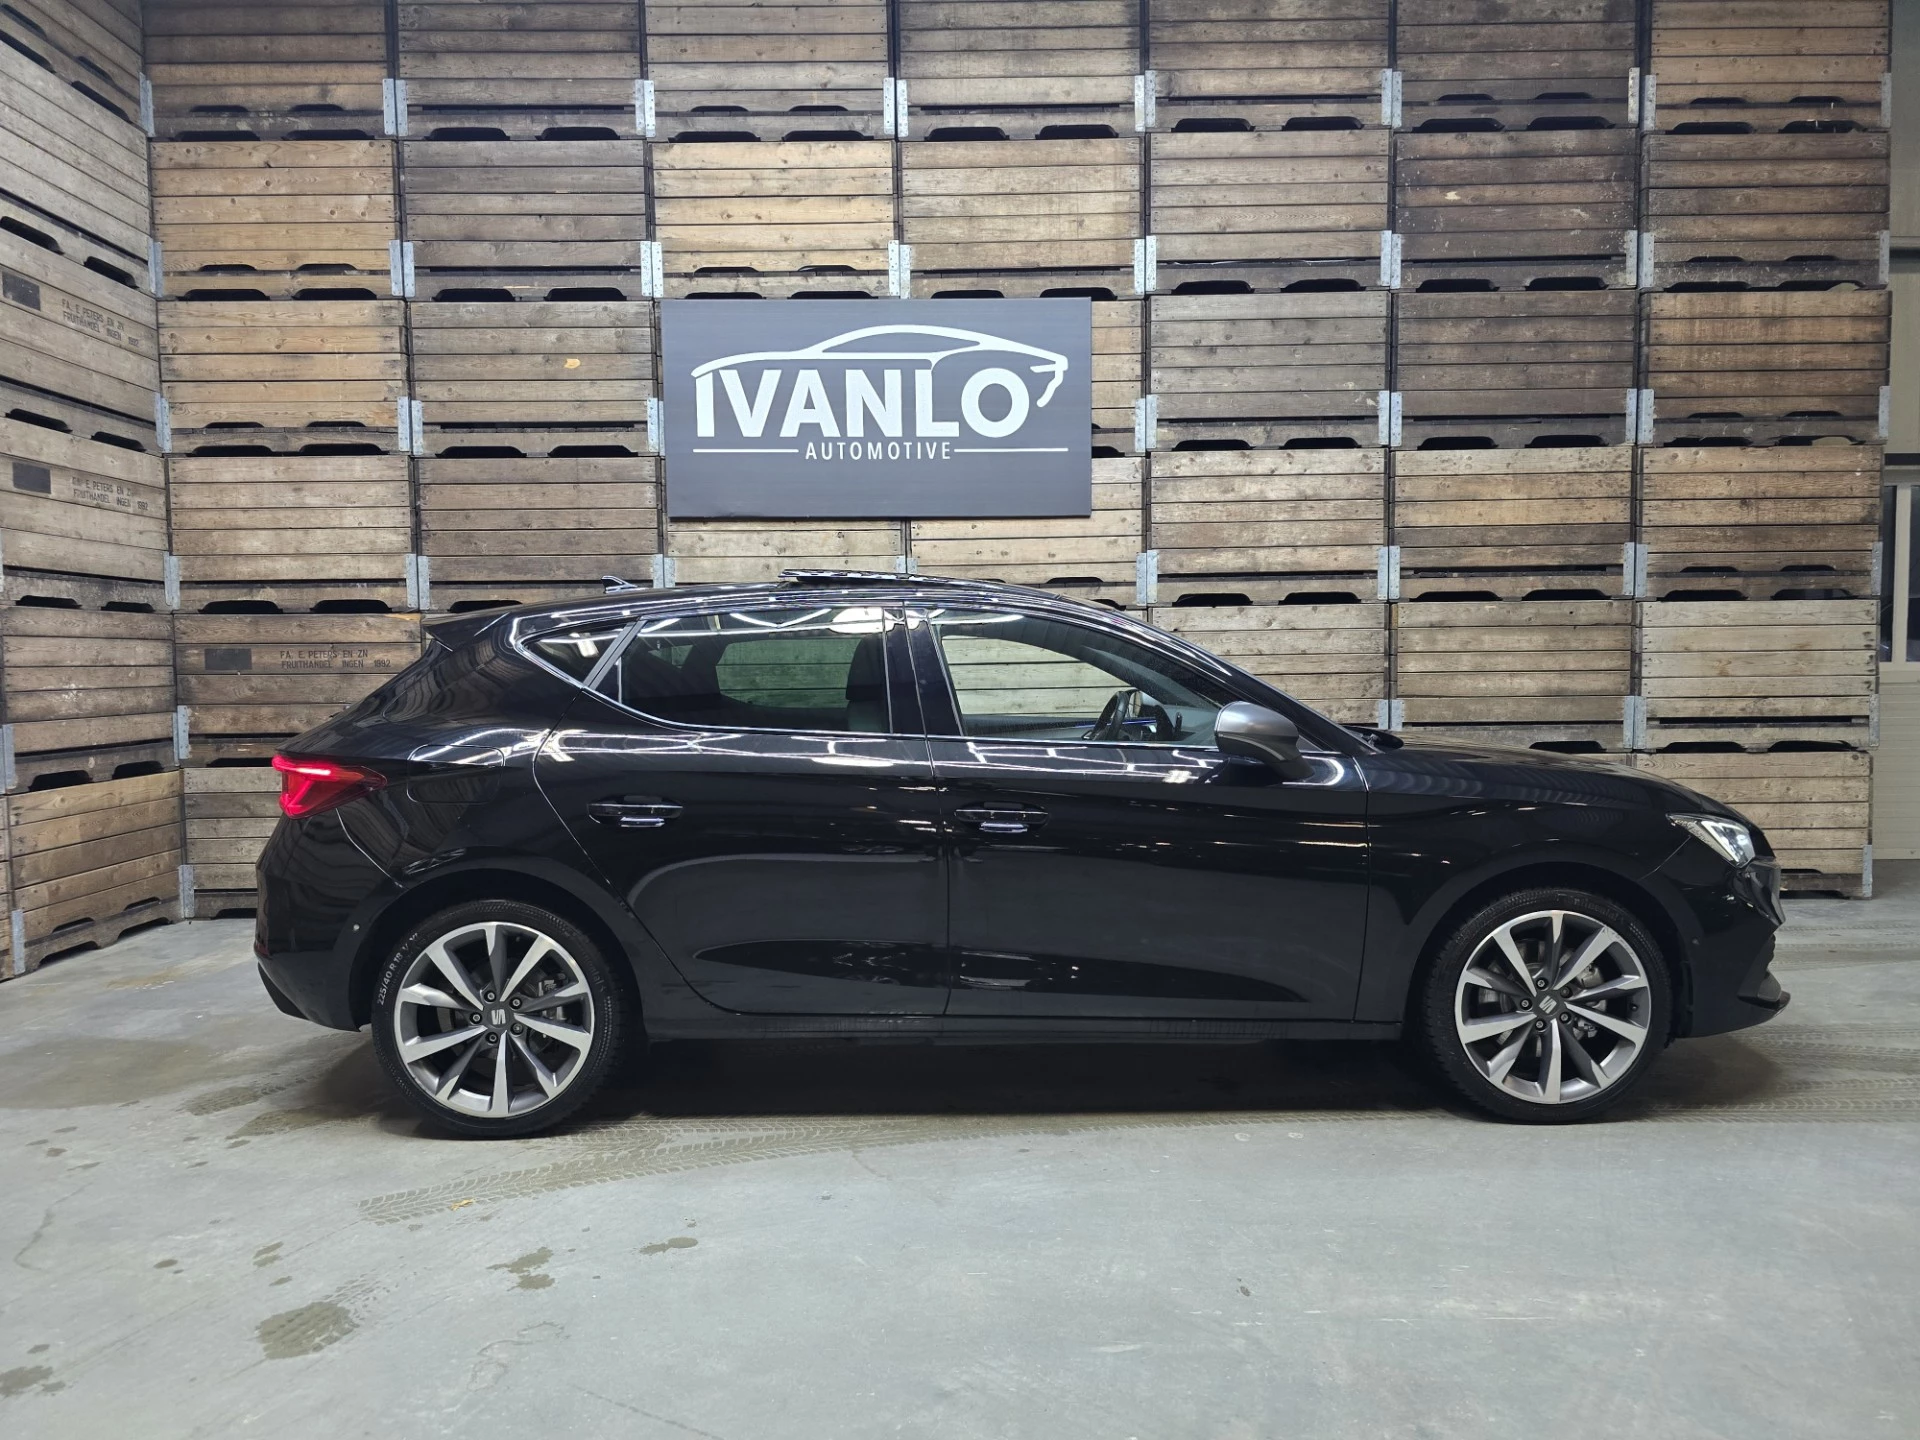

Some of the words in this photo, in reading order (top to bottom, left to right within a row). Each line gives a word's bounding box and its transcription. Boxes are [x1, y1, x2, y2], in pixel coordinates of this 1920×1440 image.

[83, 307, 104, 323] PETERS
[696, 368, 1029, 437] IVANLO
[805, 442, 951, 460] AUTOMOTIVE
[93, 481, 113, 493] PETERS
[117, 485, 124, 495] EN
[73, 488, 110, 503] FRUITHANDEL
[117, 497, 131, 507] INGEN
[308, 650, 338, 659] PETERS
[343, 650, 353, 658] EN
[357, 649, 368, 658] ZN
[281, 660, 333, 669] FRUITHANDEL
[342, 659, 364, 668] INGEN
[393, 952, 404, 963] 18
[389, 962, 398, 971] R
[377, 971, 393, 1006] 225/40
